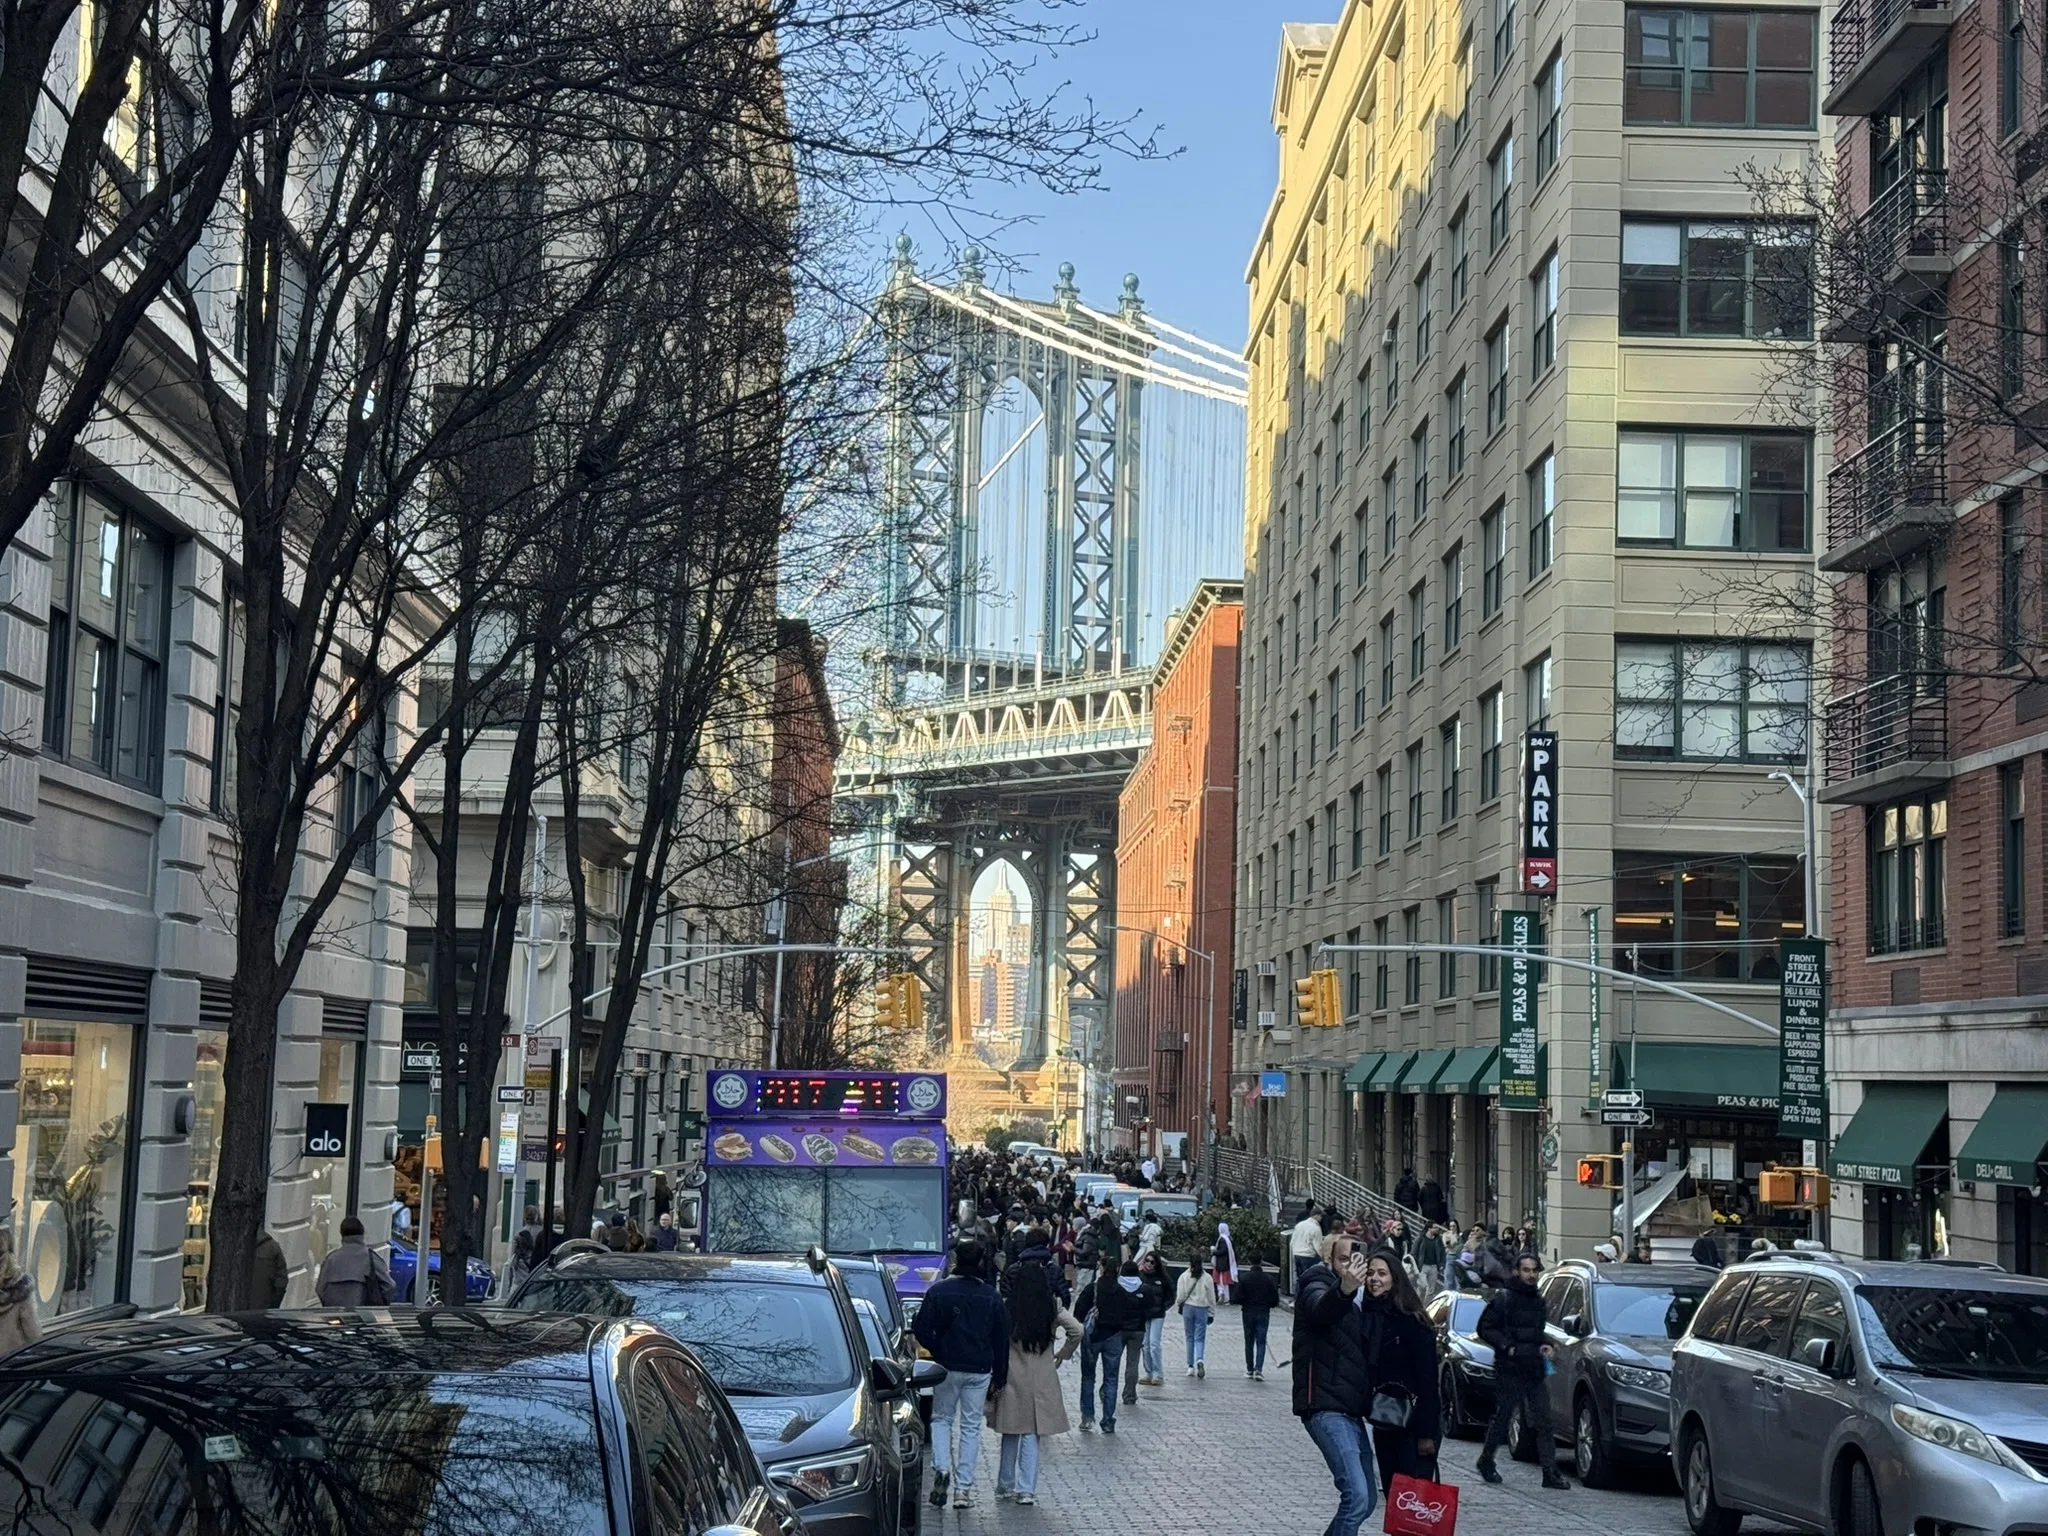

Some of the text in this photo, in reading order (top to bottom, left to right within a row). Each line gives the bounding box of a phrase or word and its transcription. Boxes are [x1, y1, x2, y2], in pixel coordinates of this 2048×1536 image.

[1530, 738, 1552, 746] 24/7
[1531, 750, 1551, 848] PARK
[1789, 954, 1816, 962] FRONT
[1787, 962, 1819, 971] STREET
[1512, 972, 1527, 985] &
[1785, 971, 1821, 984] PIZZA
[1784, 987, 1797, 995] DELI
[1805, 988, 1821, 996] GRILL
[1512, 987, 1527, 1022] PEAS
[1787, 998, 1818, 1008] LUNCH
[1799, 1007, 1807, 1016] &
[1785, 1015, 1820, 1025] DINNER
[1785, 1031, 1800, 1040] BEER
[1787, 1049, 1818, 1058] ESPRESSO
[410, 1056, 428, 1065] ONE
[1783, 1081, 1796, 1090] FREE
[503, 1090, 519, 1098] ONE
[526, 1090, 532, 1105] 2
[1717, 1095, 1747, 1106] PEAS
[1749, 1097, 1759, 1107] &
[1783, 1105, 1821, 1116] 875-3700
[1782, 1114, 1799, 1123] OPEN
[1805, 1116, 1822, 1125] DAYS
[310, 1130, 341, 1152] alo
[1836, 1163, 1901, 1182] FRONT STREET PIZZA
[1976, 1163, 2013, 1180] DELI GRILL
